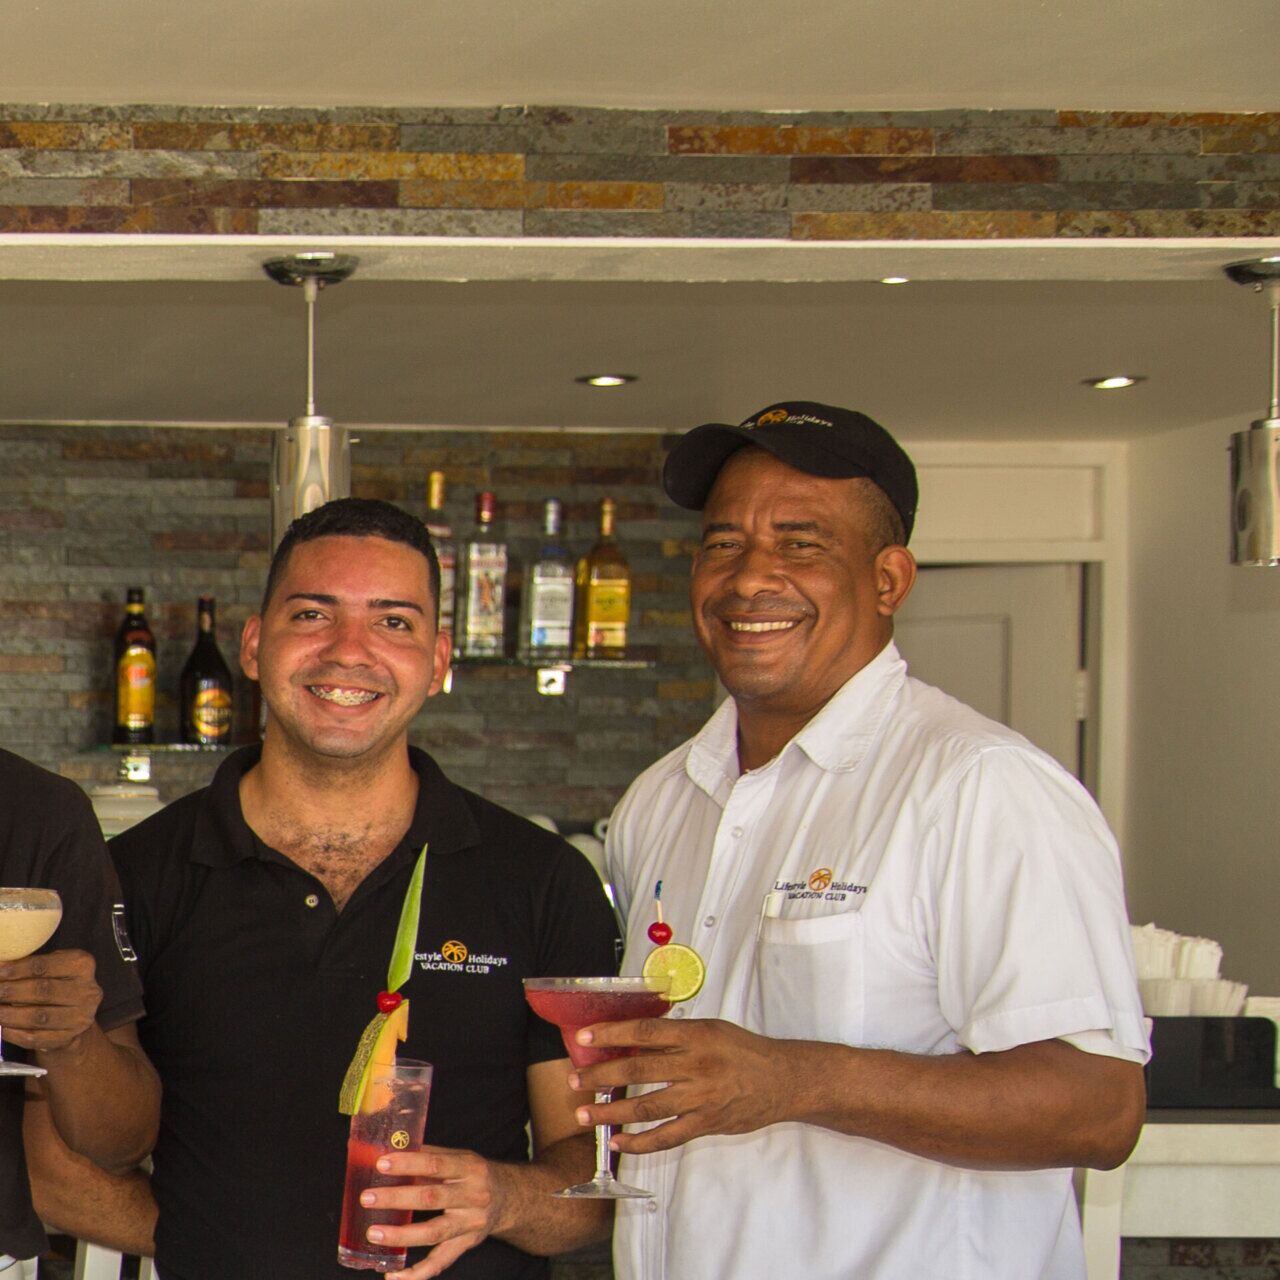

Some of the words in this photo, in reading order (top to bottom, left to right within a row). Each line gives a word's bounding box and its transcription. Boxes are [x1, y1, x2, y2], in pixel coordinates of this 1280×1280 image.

[830, 881, 868, 894] Holidays
[788, 891, 822, 900] VACATION
[824, 892, 847, 902] CLUB
[413, 951, 442, 963] estyle
[468, 954, 508, 967] Holidays
[421, 961, 463, 972] VACATION
[465, 964, 490, 974] CLUB
